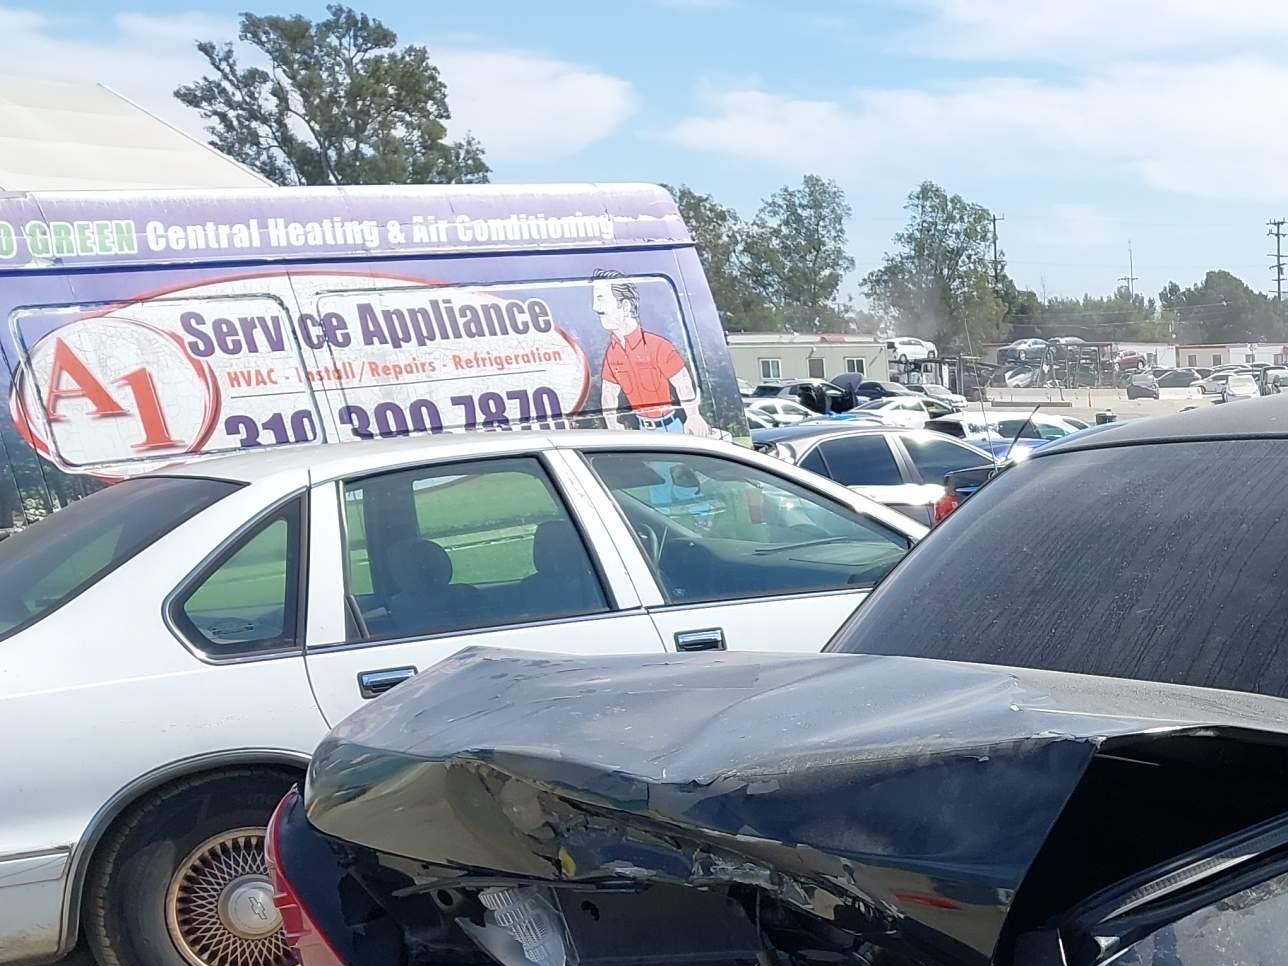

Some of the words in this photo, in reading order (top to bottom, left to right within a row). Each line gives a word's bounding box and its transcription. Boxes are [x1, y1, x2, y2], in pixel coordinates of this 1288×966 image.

[26, 220, 137, 257] GREEN
[146, 218, 260, 250] Central
[267, 216, 380, 247] Heating
[387, 220, 406, 243] &
[411, 215, 448, 243] Air
[456, 211, 615, 240] Conditioning
[356, 298, 552, 348] Appliance
[228, 368, 278, 388] HVAC
[452, 347, 562, 370] Refrigeration
[224, 409, 317, 447] 310
